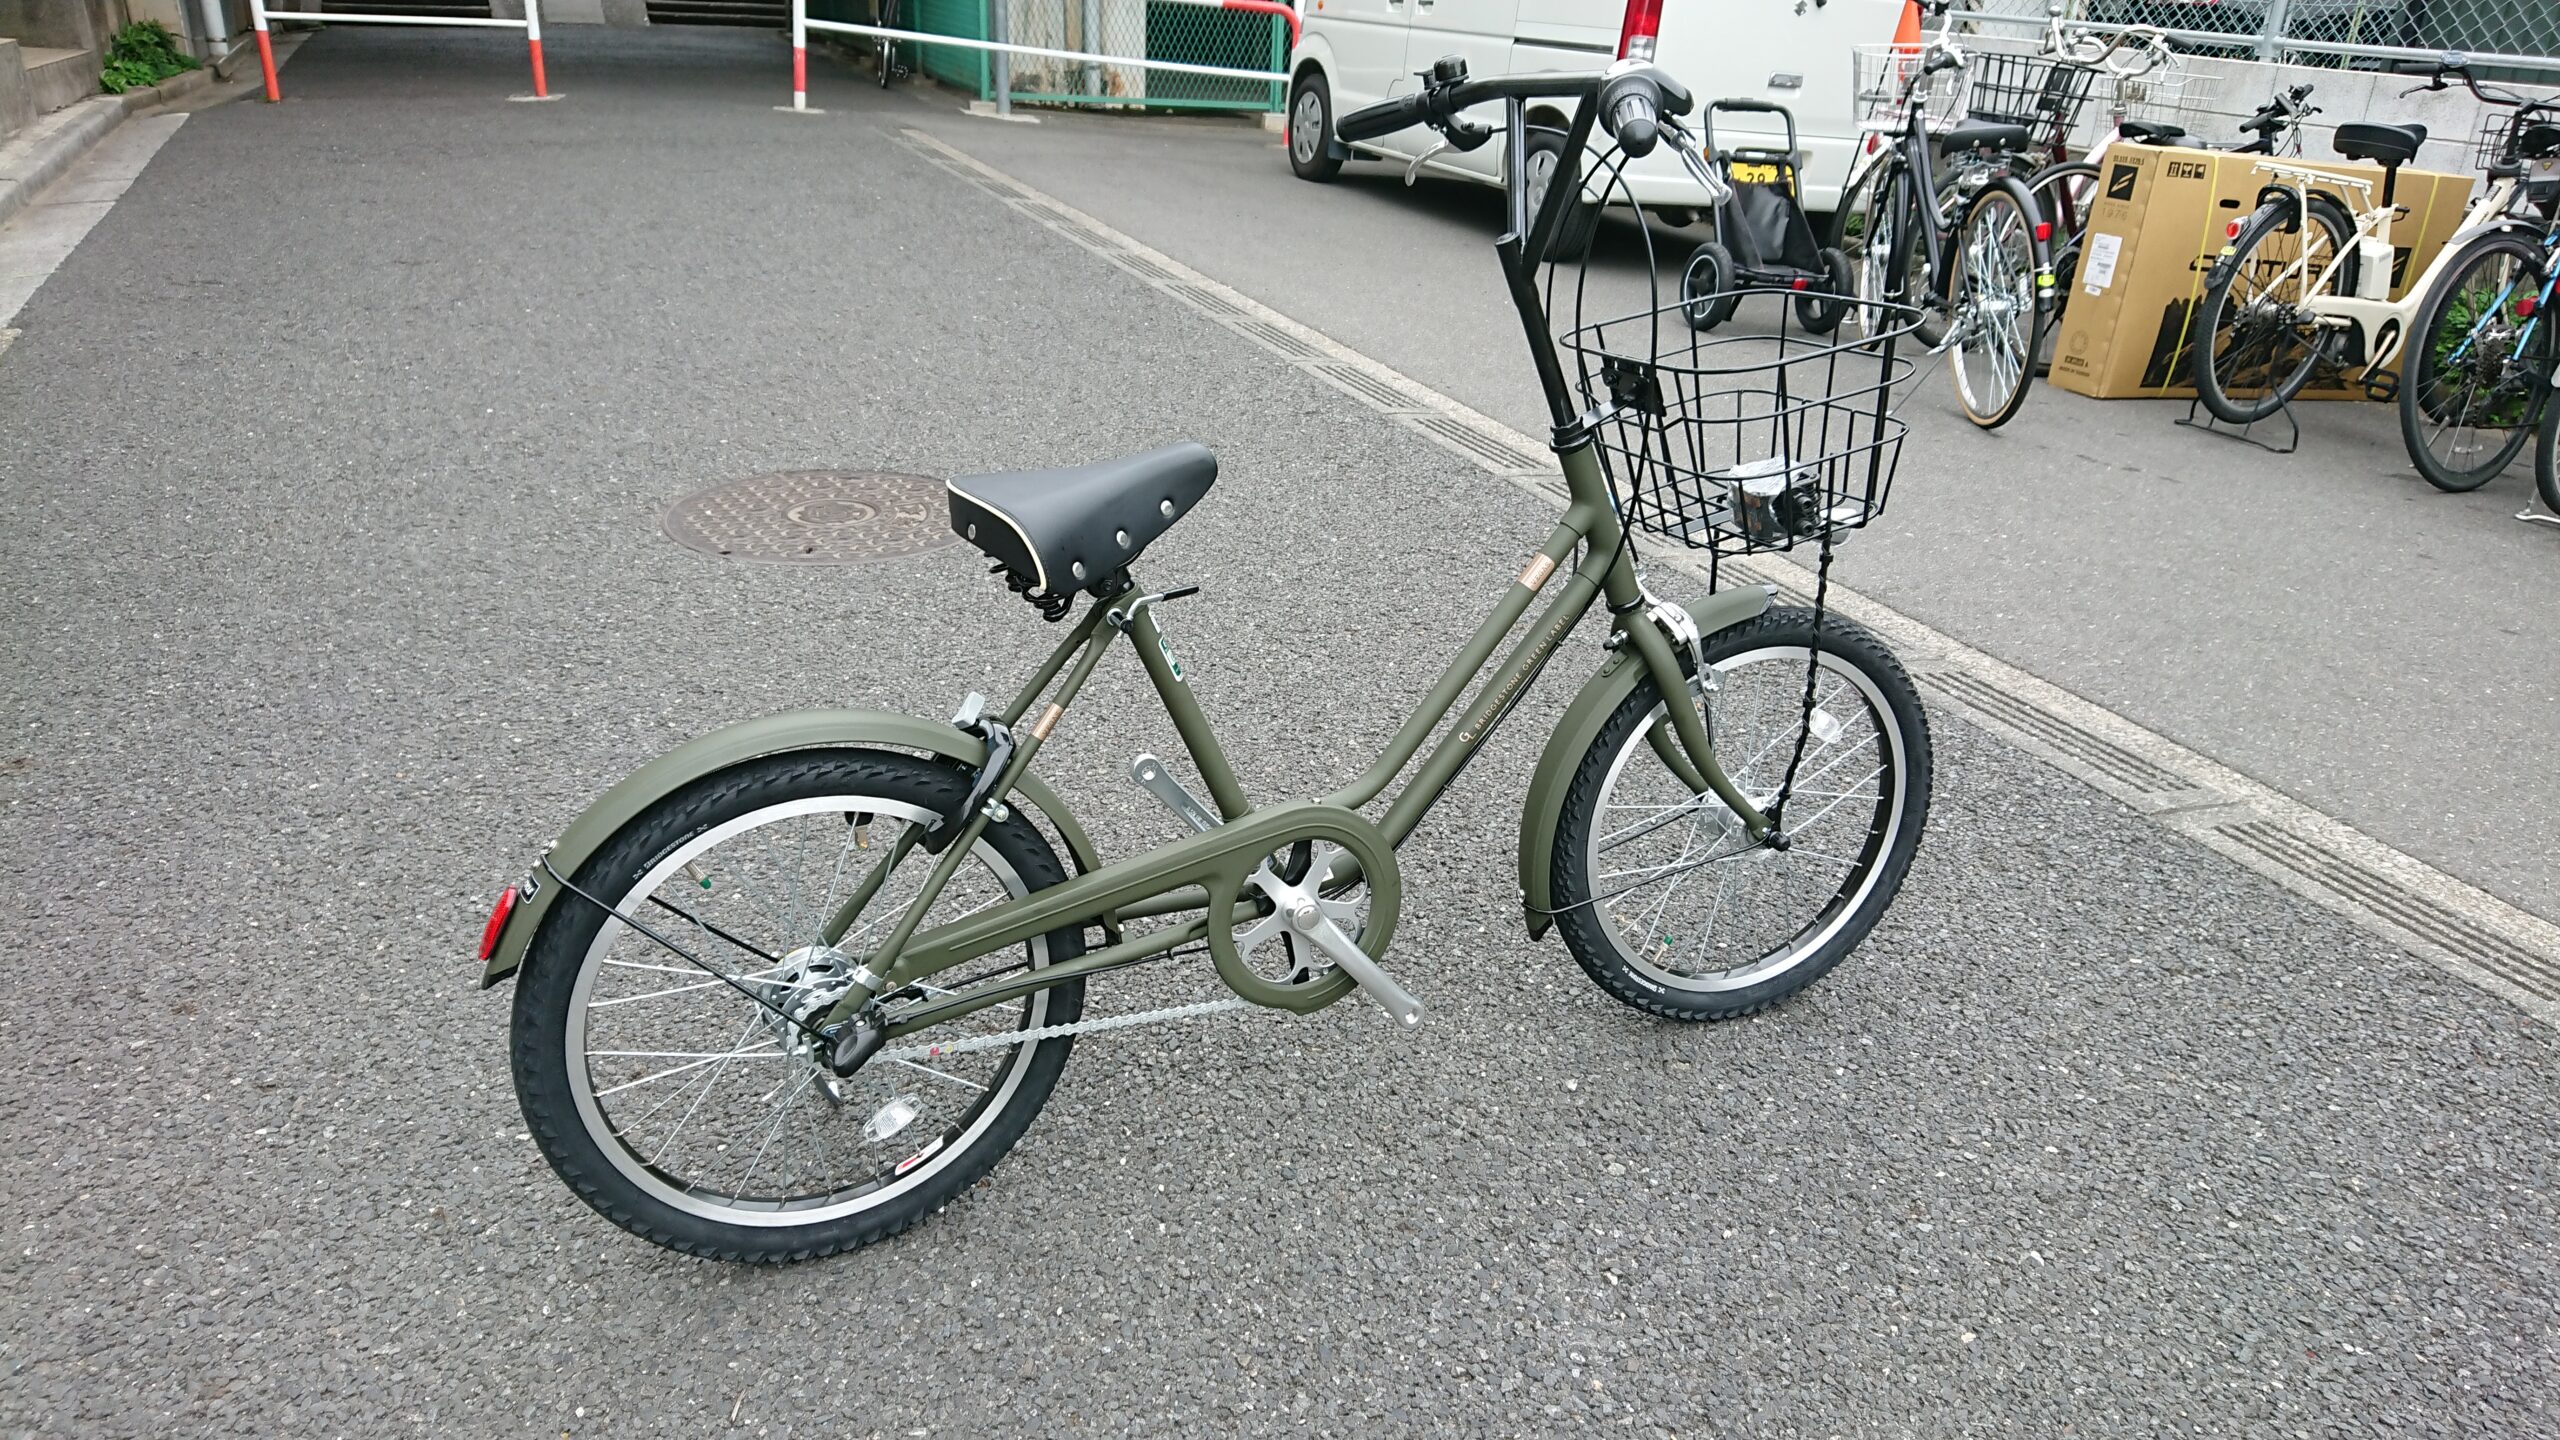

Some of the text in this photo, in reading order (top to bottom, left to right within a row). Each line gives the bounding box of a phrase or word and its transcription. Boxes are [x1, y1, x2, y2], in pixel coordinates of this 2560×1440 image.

[1474, 671, 1523, 731] BRIDGESTONE
[1522, 641, 1548, 671] GREEN
[1546, 614, 1570, 641] LABEL
[643, 831, 695, 869] BRIDGESTONE
